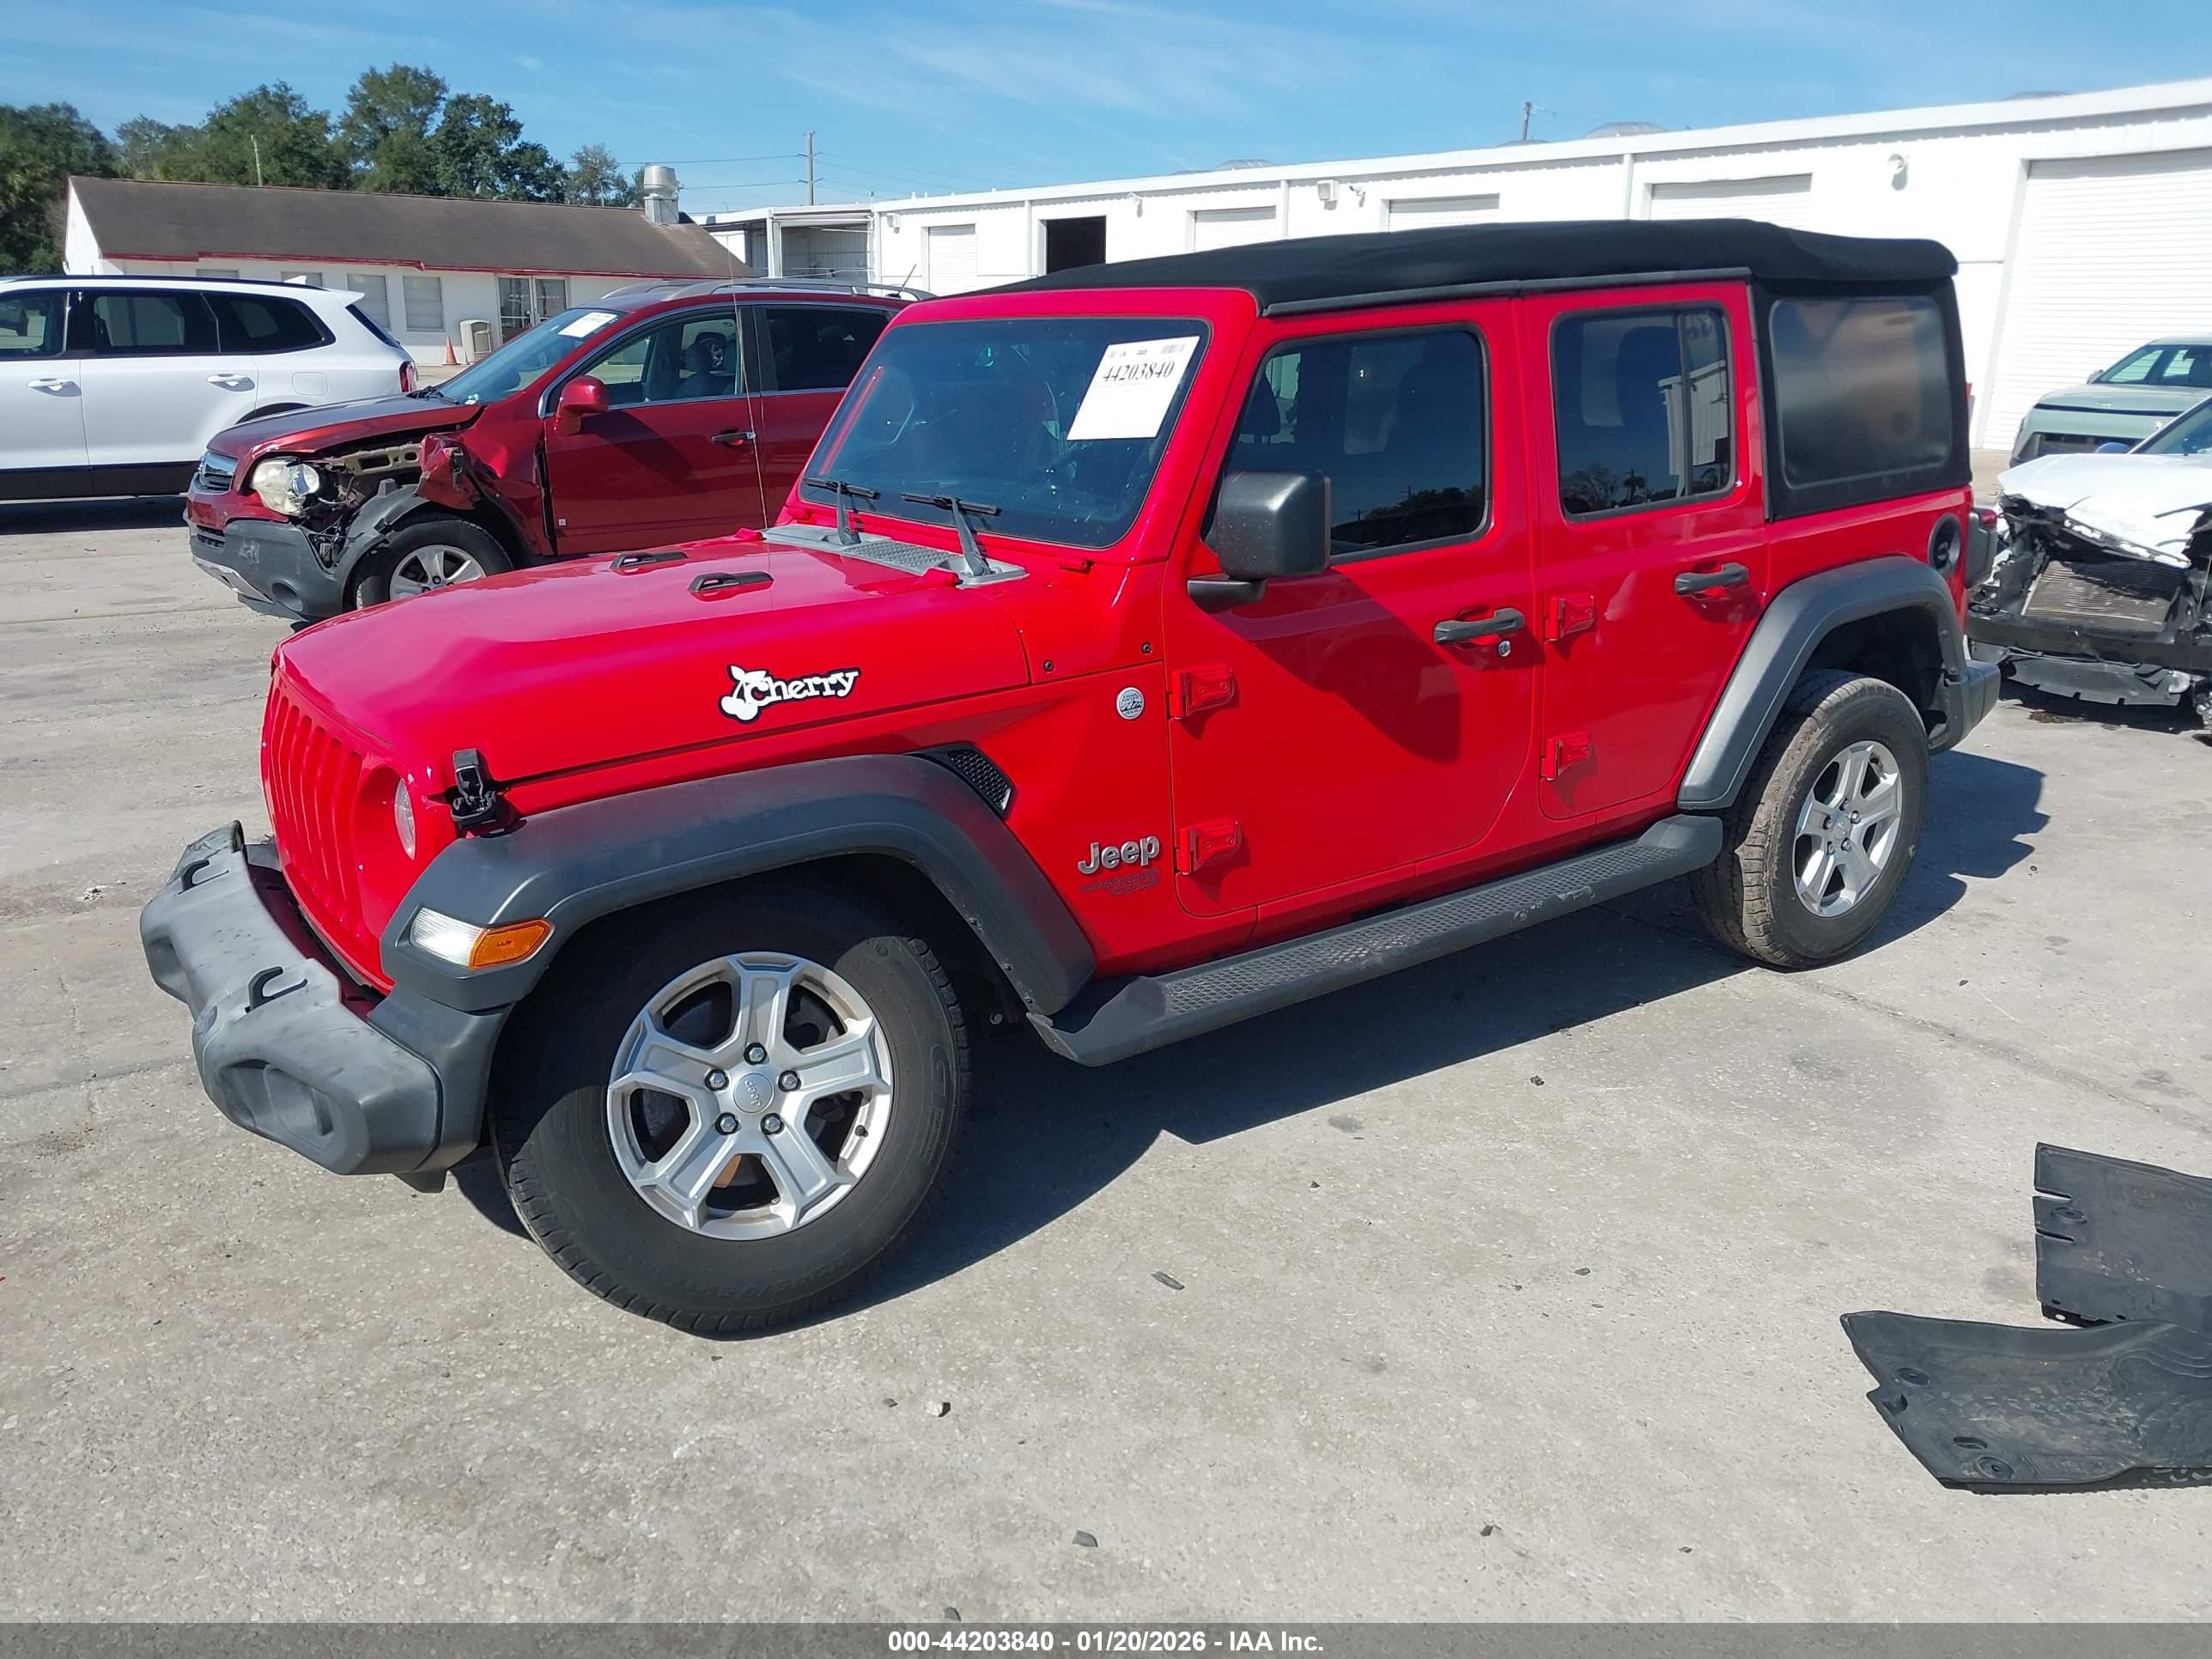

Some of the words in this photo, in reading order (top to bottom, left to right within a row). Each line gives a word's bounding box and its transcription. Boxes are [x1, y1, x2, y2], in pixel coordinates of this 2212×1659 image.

[1103, 361, 1176, 382] 44203840
[740, 667, 861, 707] Cherry
[1077, 835, 1160, 875] Jeep
